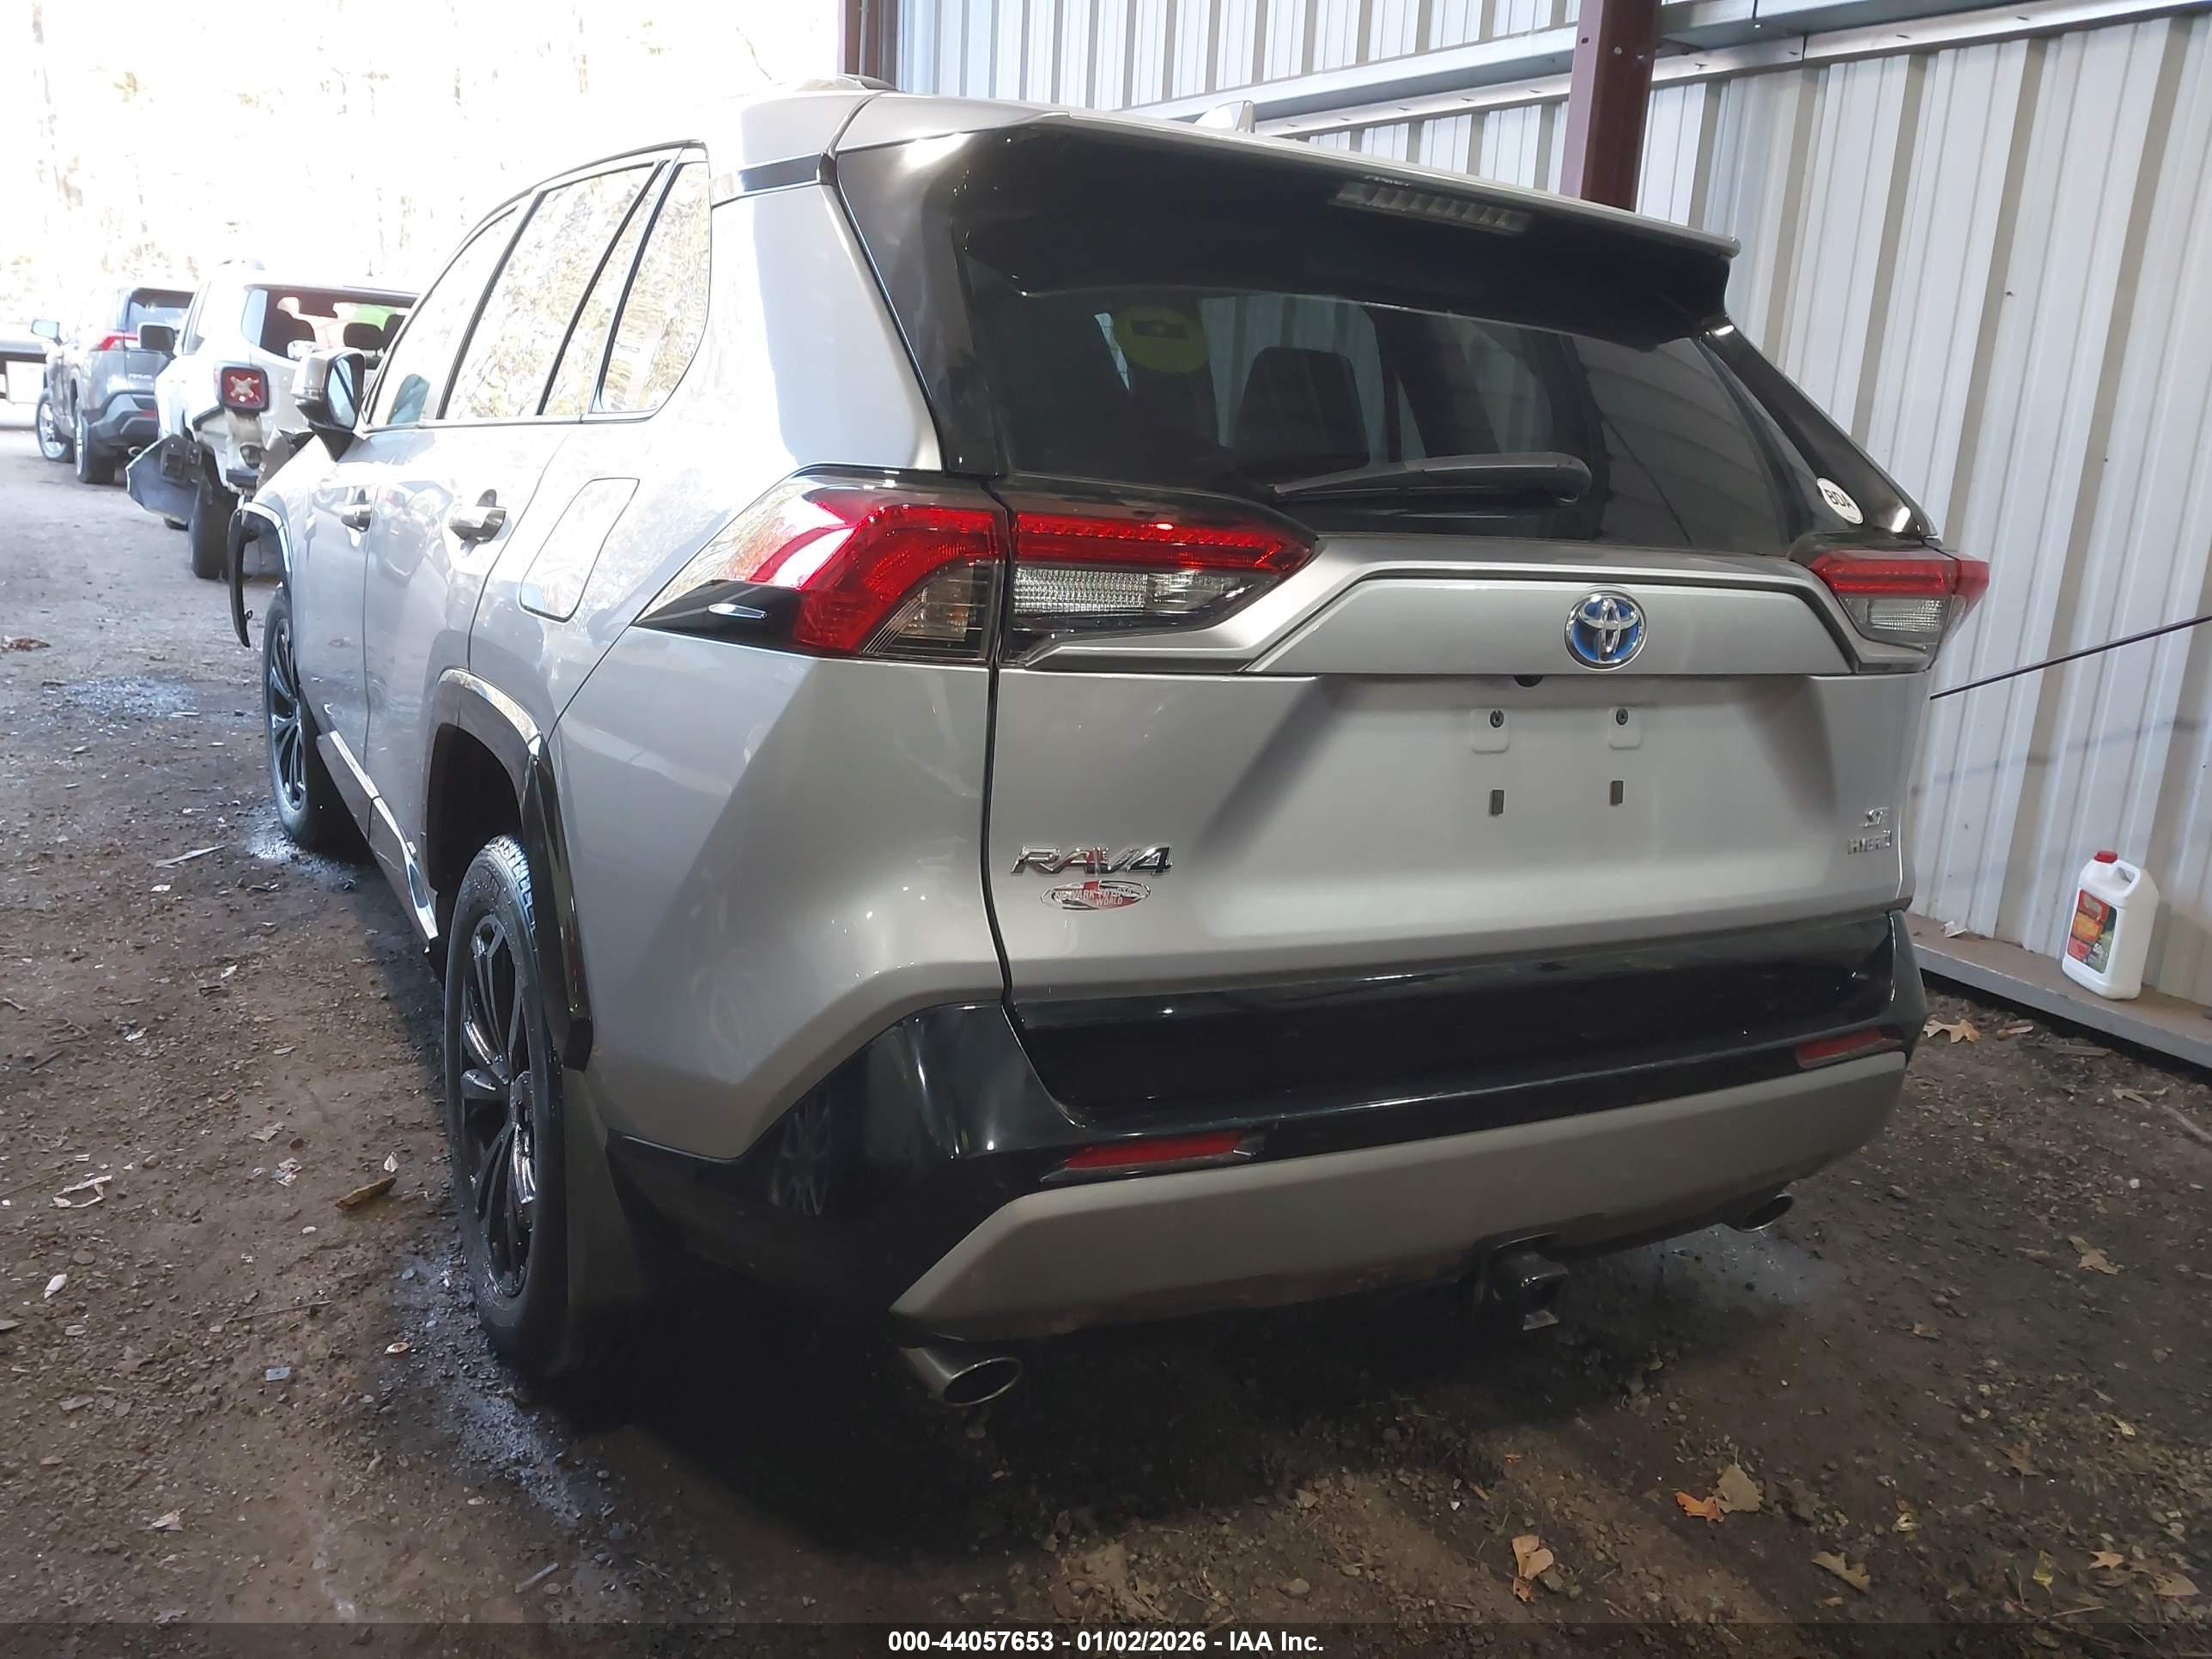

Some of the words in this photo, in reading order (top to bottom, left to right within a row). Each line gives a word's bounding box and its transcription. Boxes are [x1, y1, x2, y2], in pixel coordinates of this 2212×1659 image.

[1822, 487, 1856, 511] BDA
[1010, 845, 1173, 875] RAV4
[1096, 896, 1123, 906] WORLD
